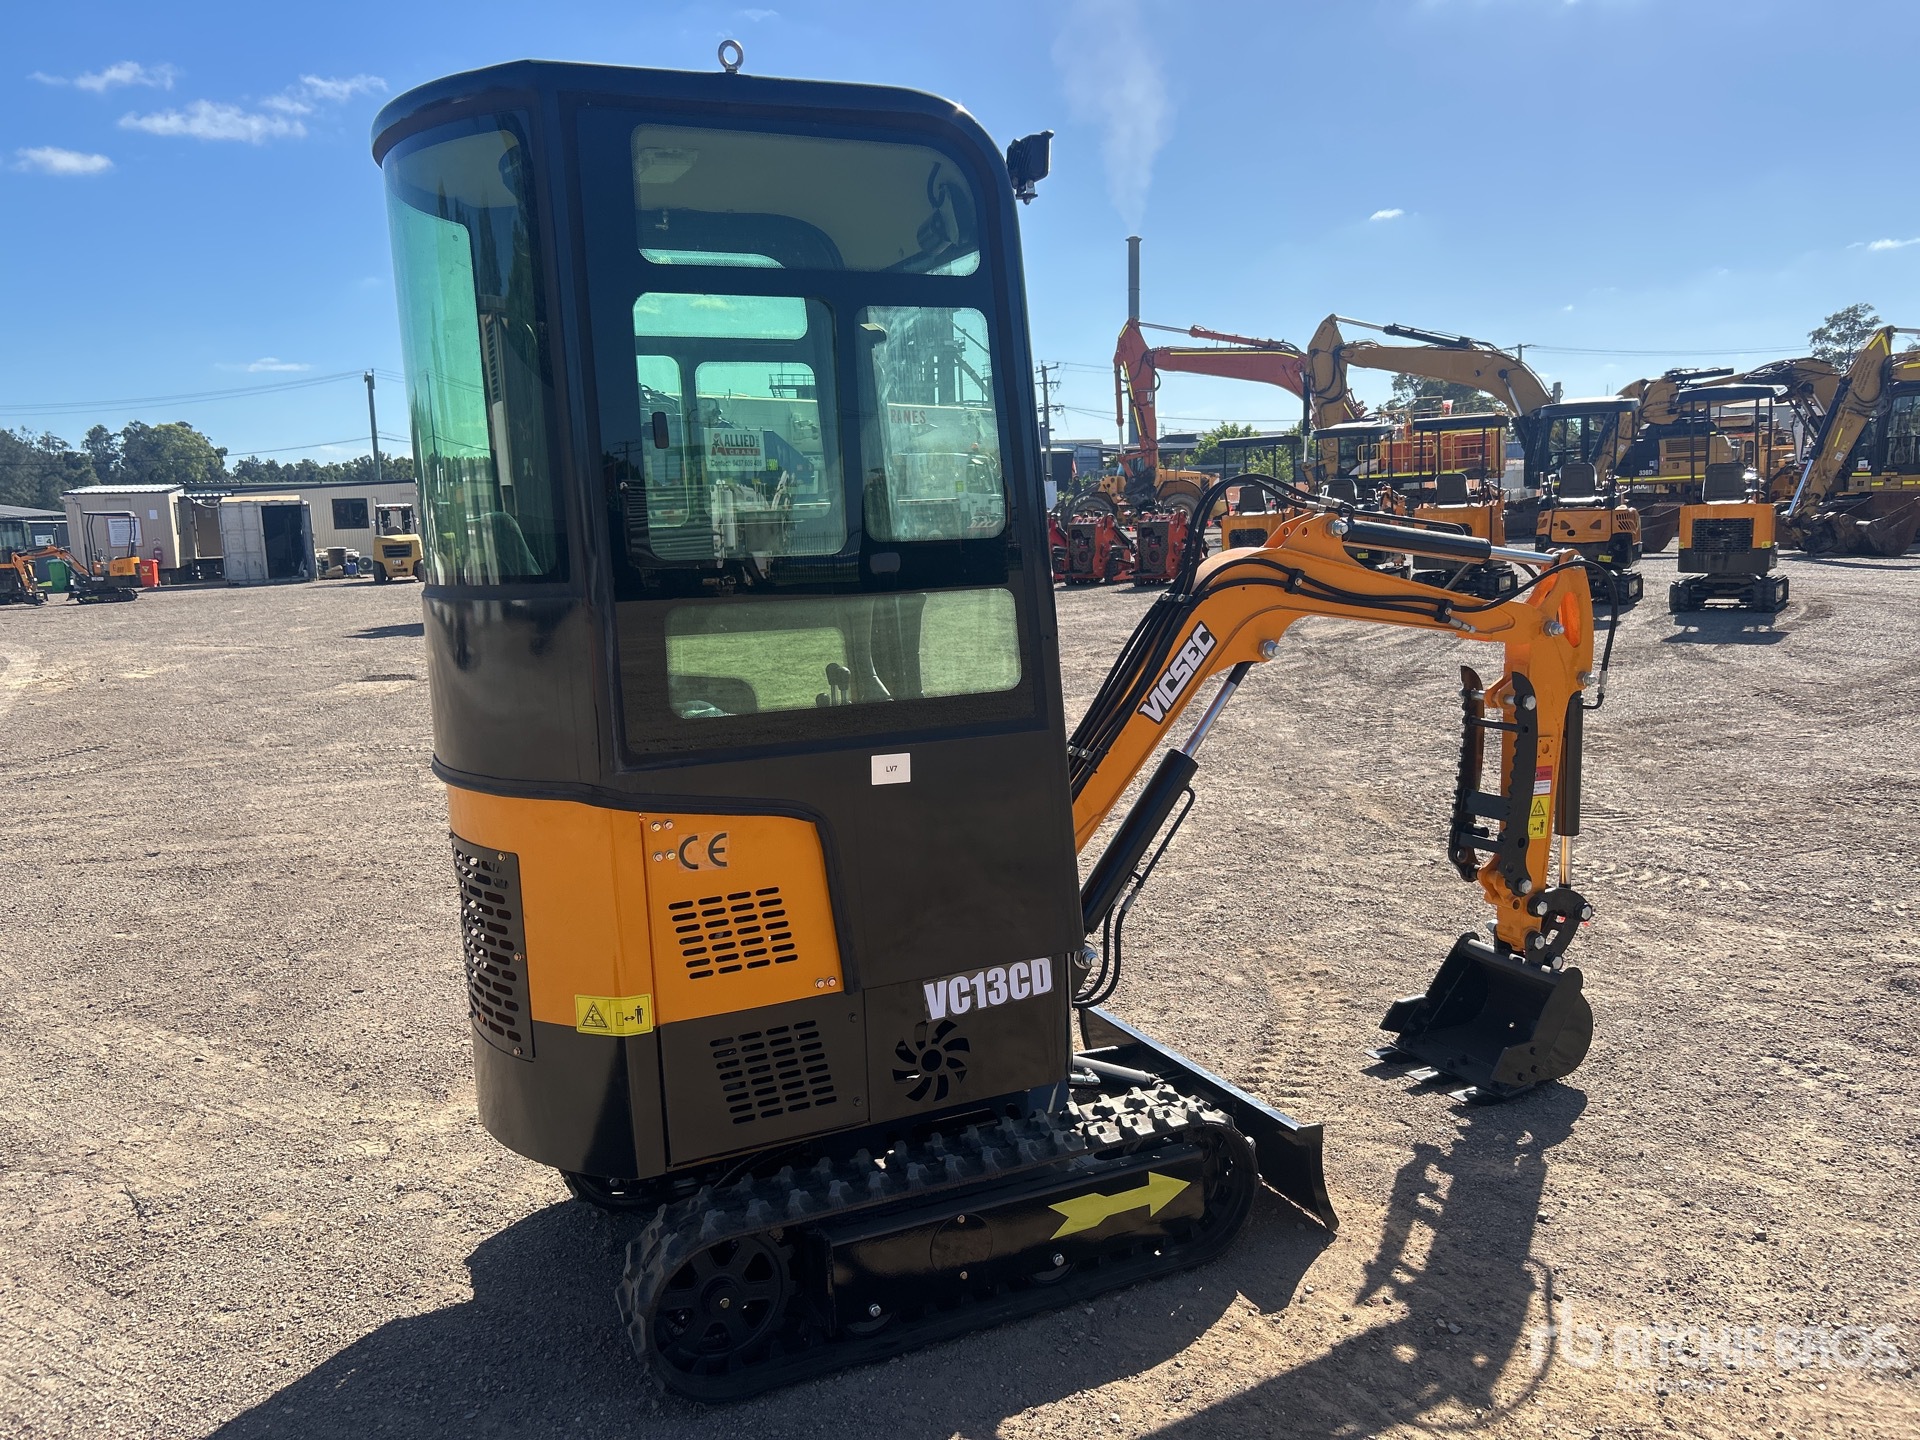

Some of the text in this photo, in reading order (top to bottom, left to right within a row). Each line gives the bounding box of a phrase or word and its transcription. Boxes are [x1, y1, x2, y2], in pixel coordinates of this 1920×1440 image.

[890, 408, 926, 424] RANES
[724, 434, 755, 448] ALLIED
[1138, 622, 1217, 723] VICSEC
[885, 765, 898, 773] LV7
[678, 832, 728, 870] CE
[923, 957, 1052, 1021] VC13CD
